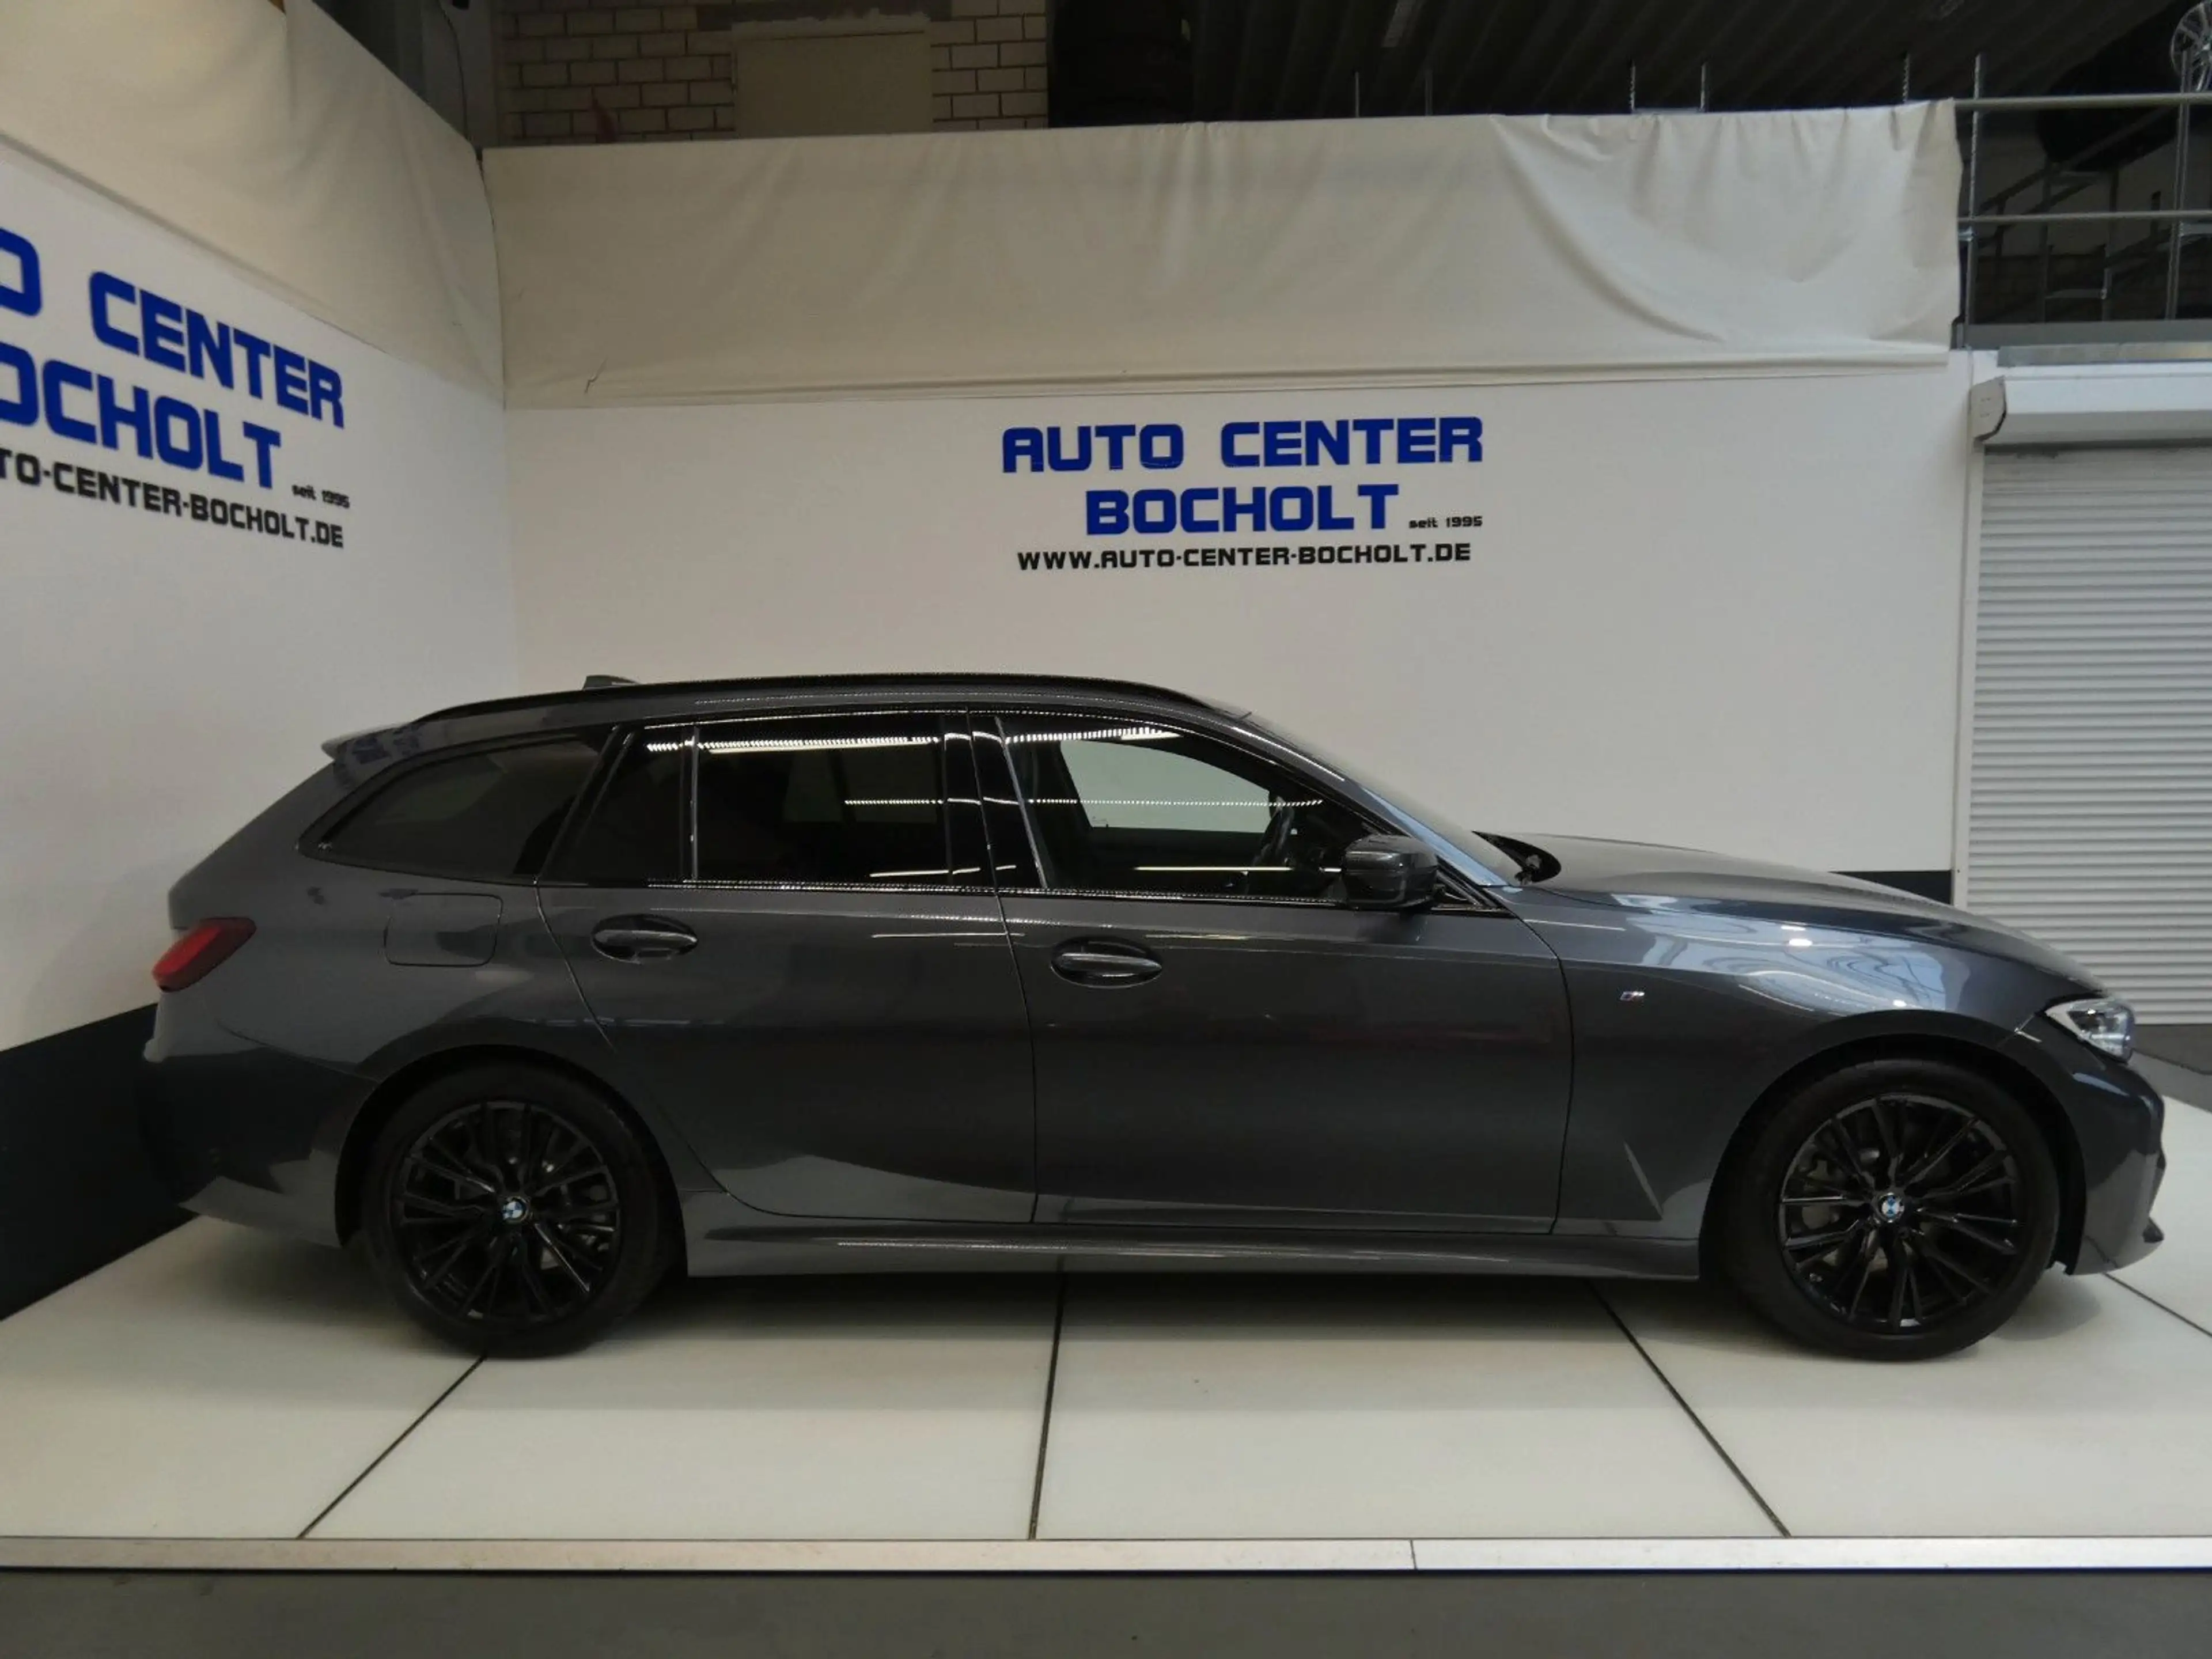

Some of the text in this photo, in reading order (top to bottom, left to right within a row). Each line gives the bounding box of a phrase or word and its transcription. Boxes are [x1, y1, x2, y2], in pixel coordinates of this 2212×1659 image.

[89, 271, 344, 429] CENTER
[1003, 416, 1483, 472] AUTO CENTER
[1086, 484, 1483, 536] BOCHOLT seit 1995
[1017, 543, 1471, 570] WWW.AUTO-CENTER-BOCHOLT.DE
